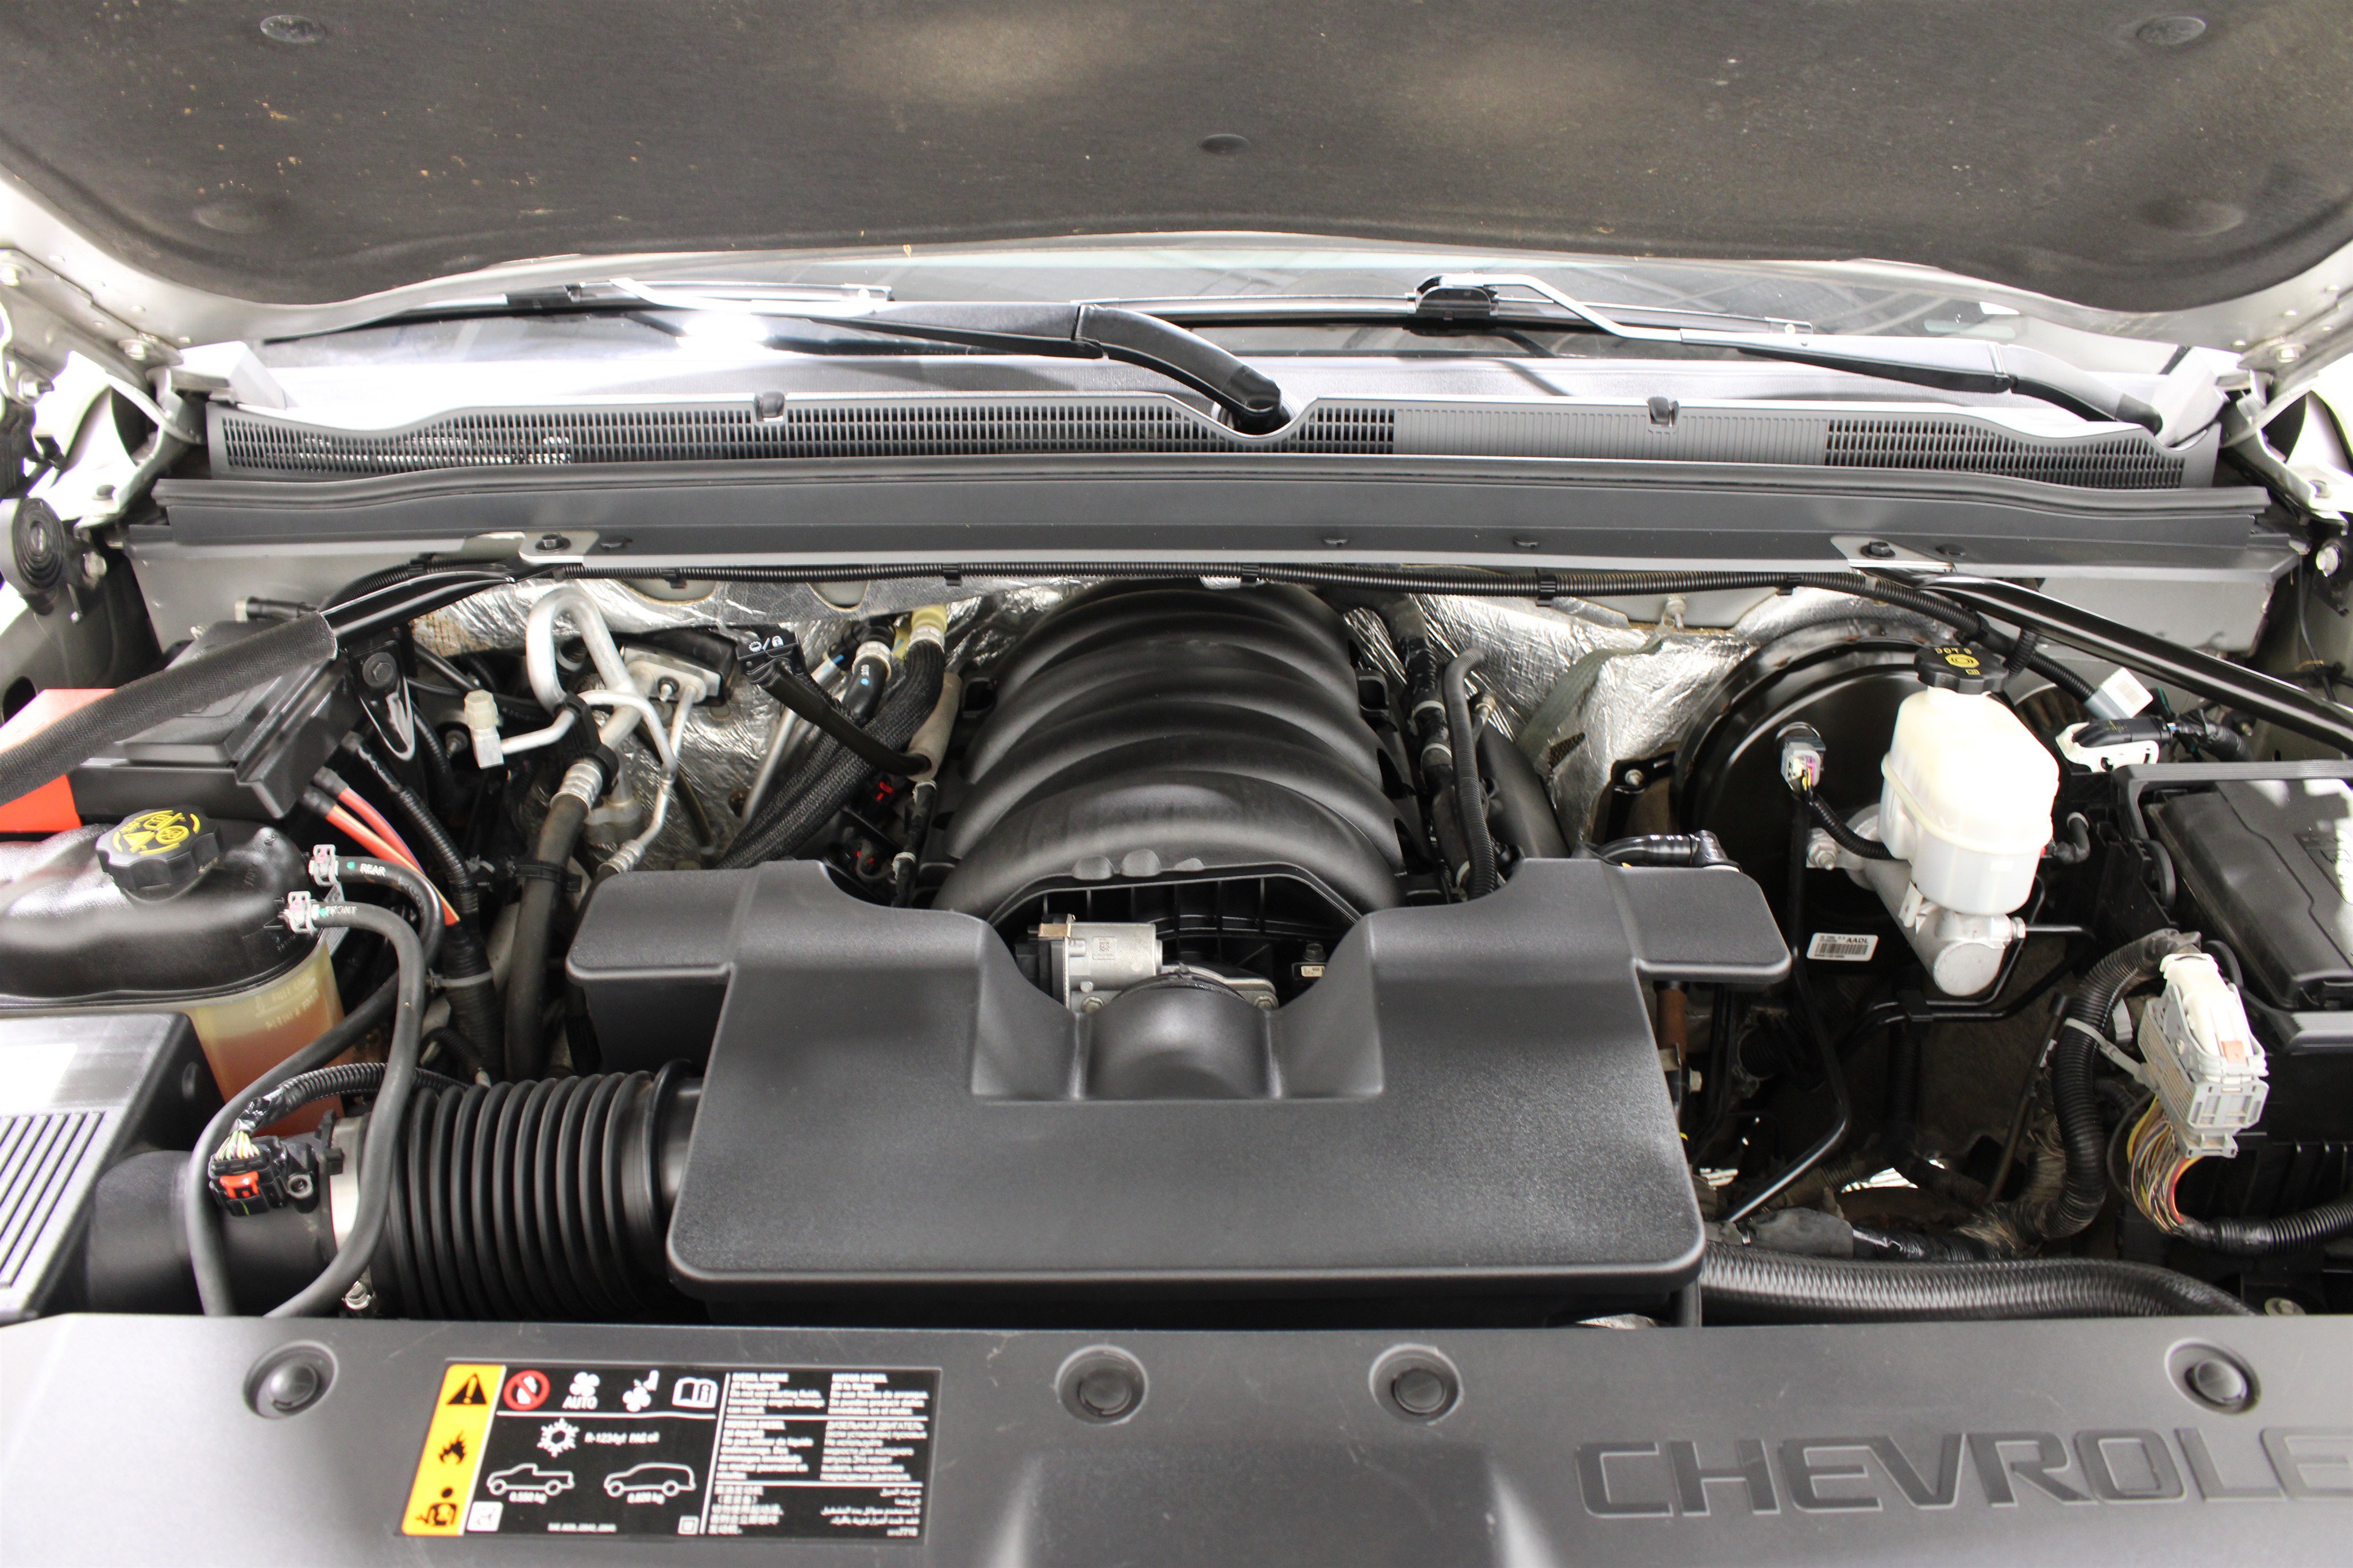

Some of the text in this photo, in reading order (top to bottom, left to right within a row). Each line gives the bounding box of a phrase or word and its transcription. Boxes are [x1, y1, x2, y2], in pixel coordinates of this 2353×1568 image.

[360, 863, 386, 877] REAR
[325, 905, 357, 916] FRONT
[562, 1396, 598, 1410] AUTO
